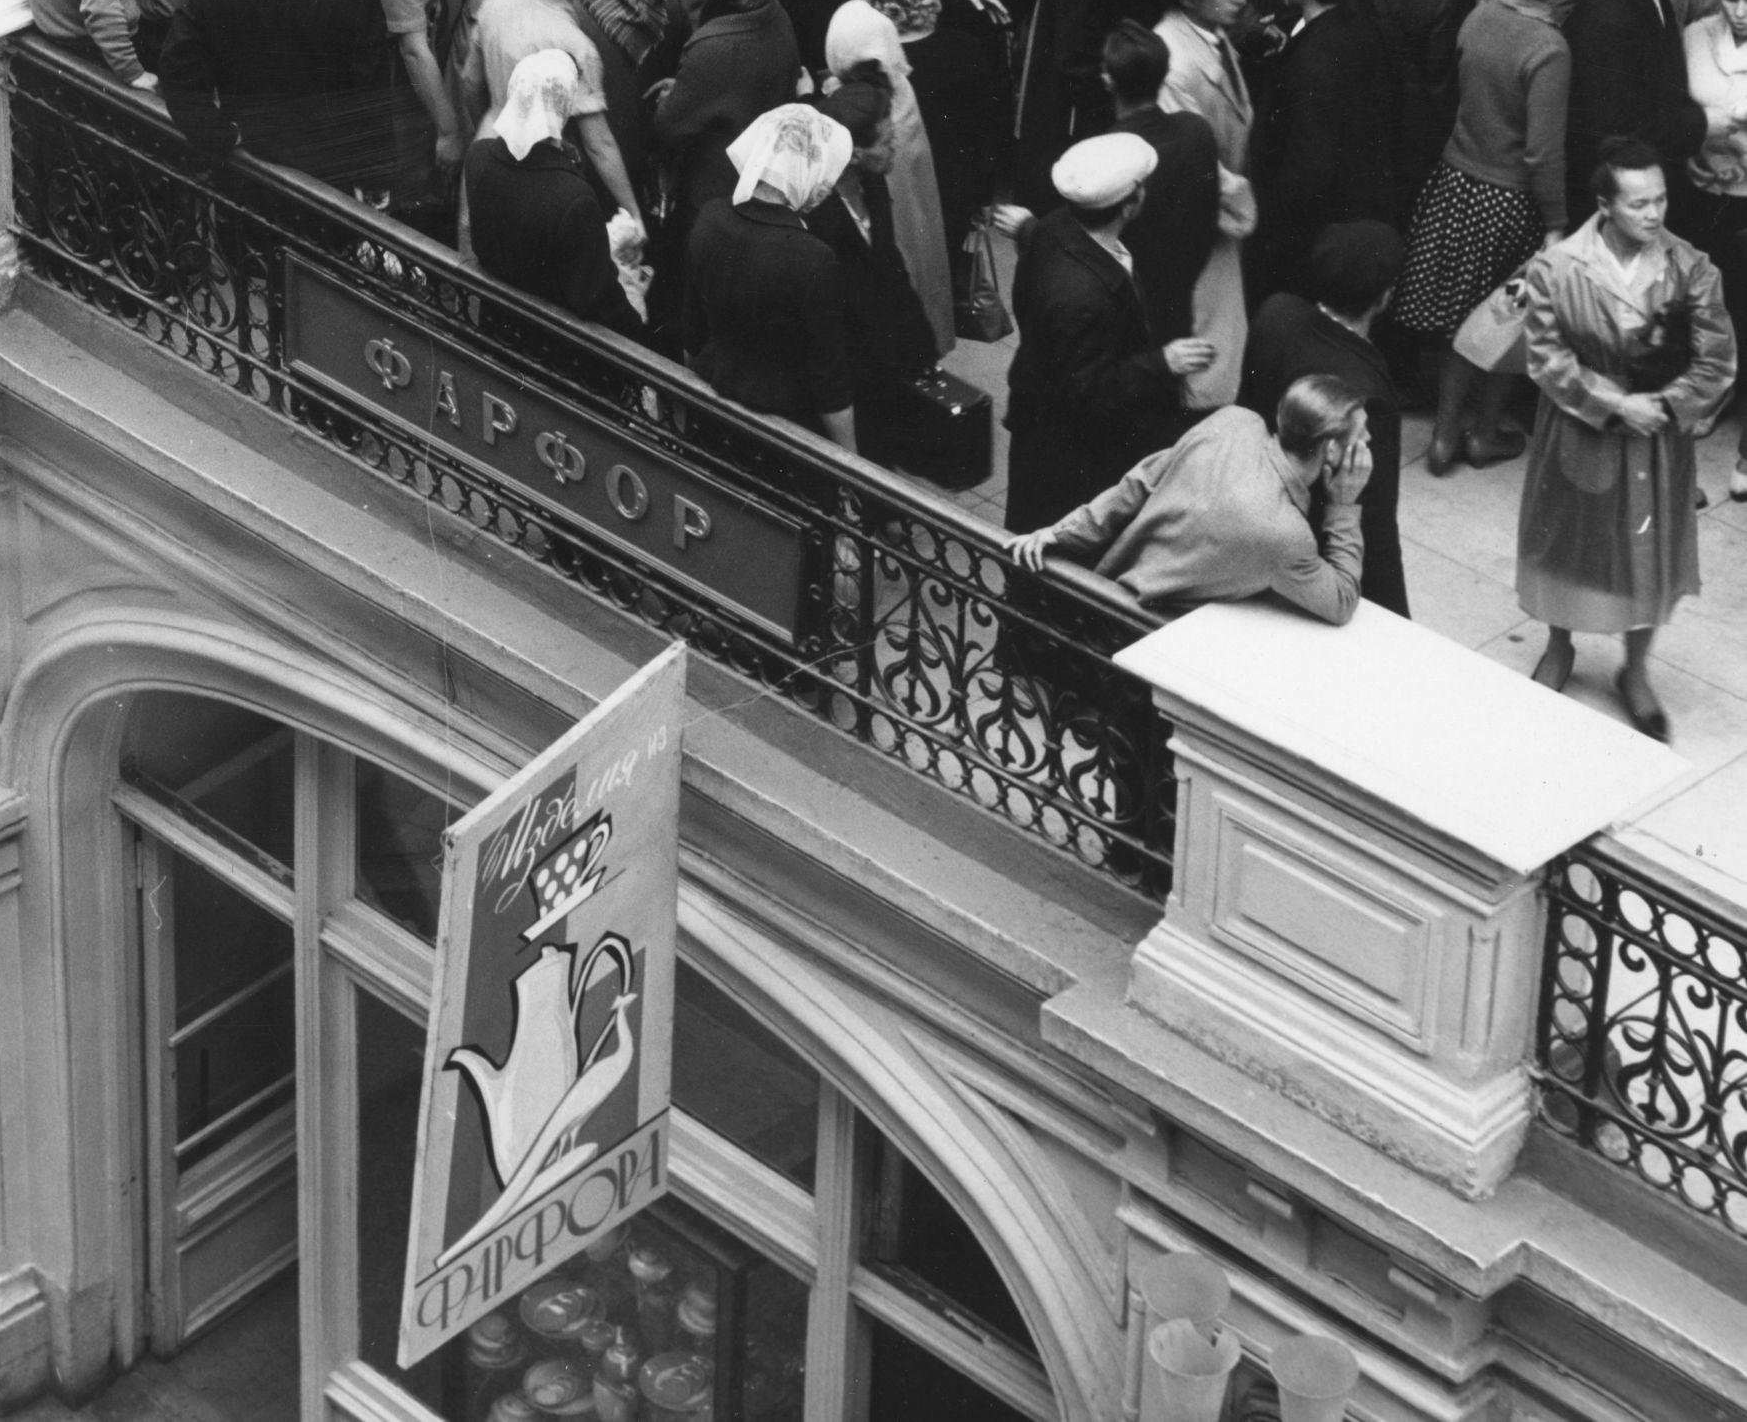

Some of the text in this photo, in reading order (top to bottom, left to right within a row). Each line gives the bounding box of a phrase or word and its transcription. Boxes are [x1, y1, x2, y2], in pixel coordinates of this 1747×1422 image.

[363, 337, 712, 551] ФАРФОР
[472, 749, 639, 915] Изделия
[416, 1130, 660, 1331] ФАРФОРА
